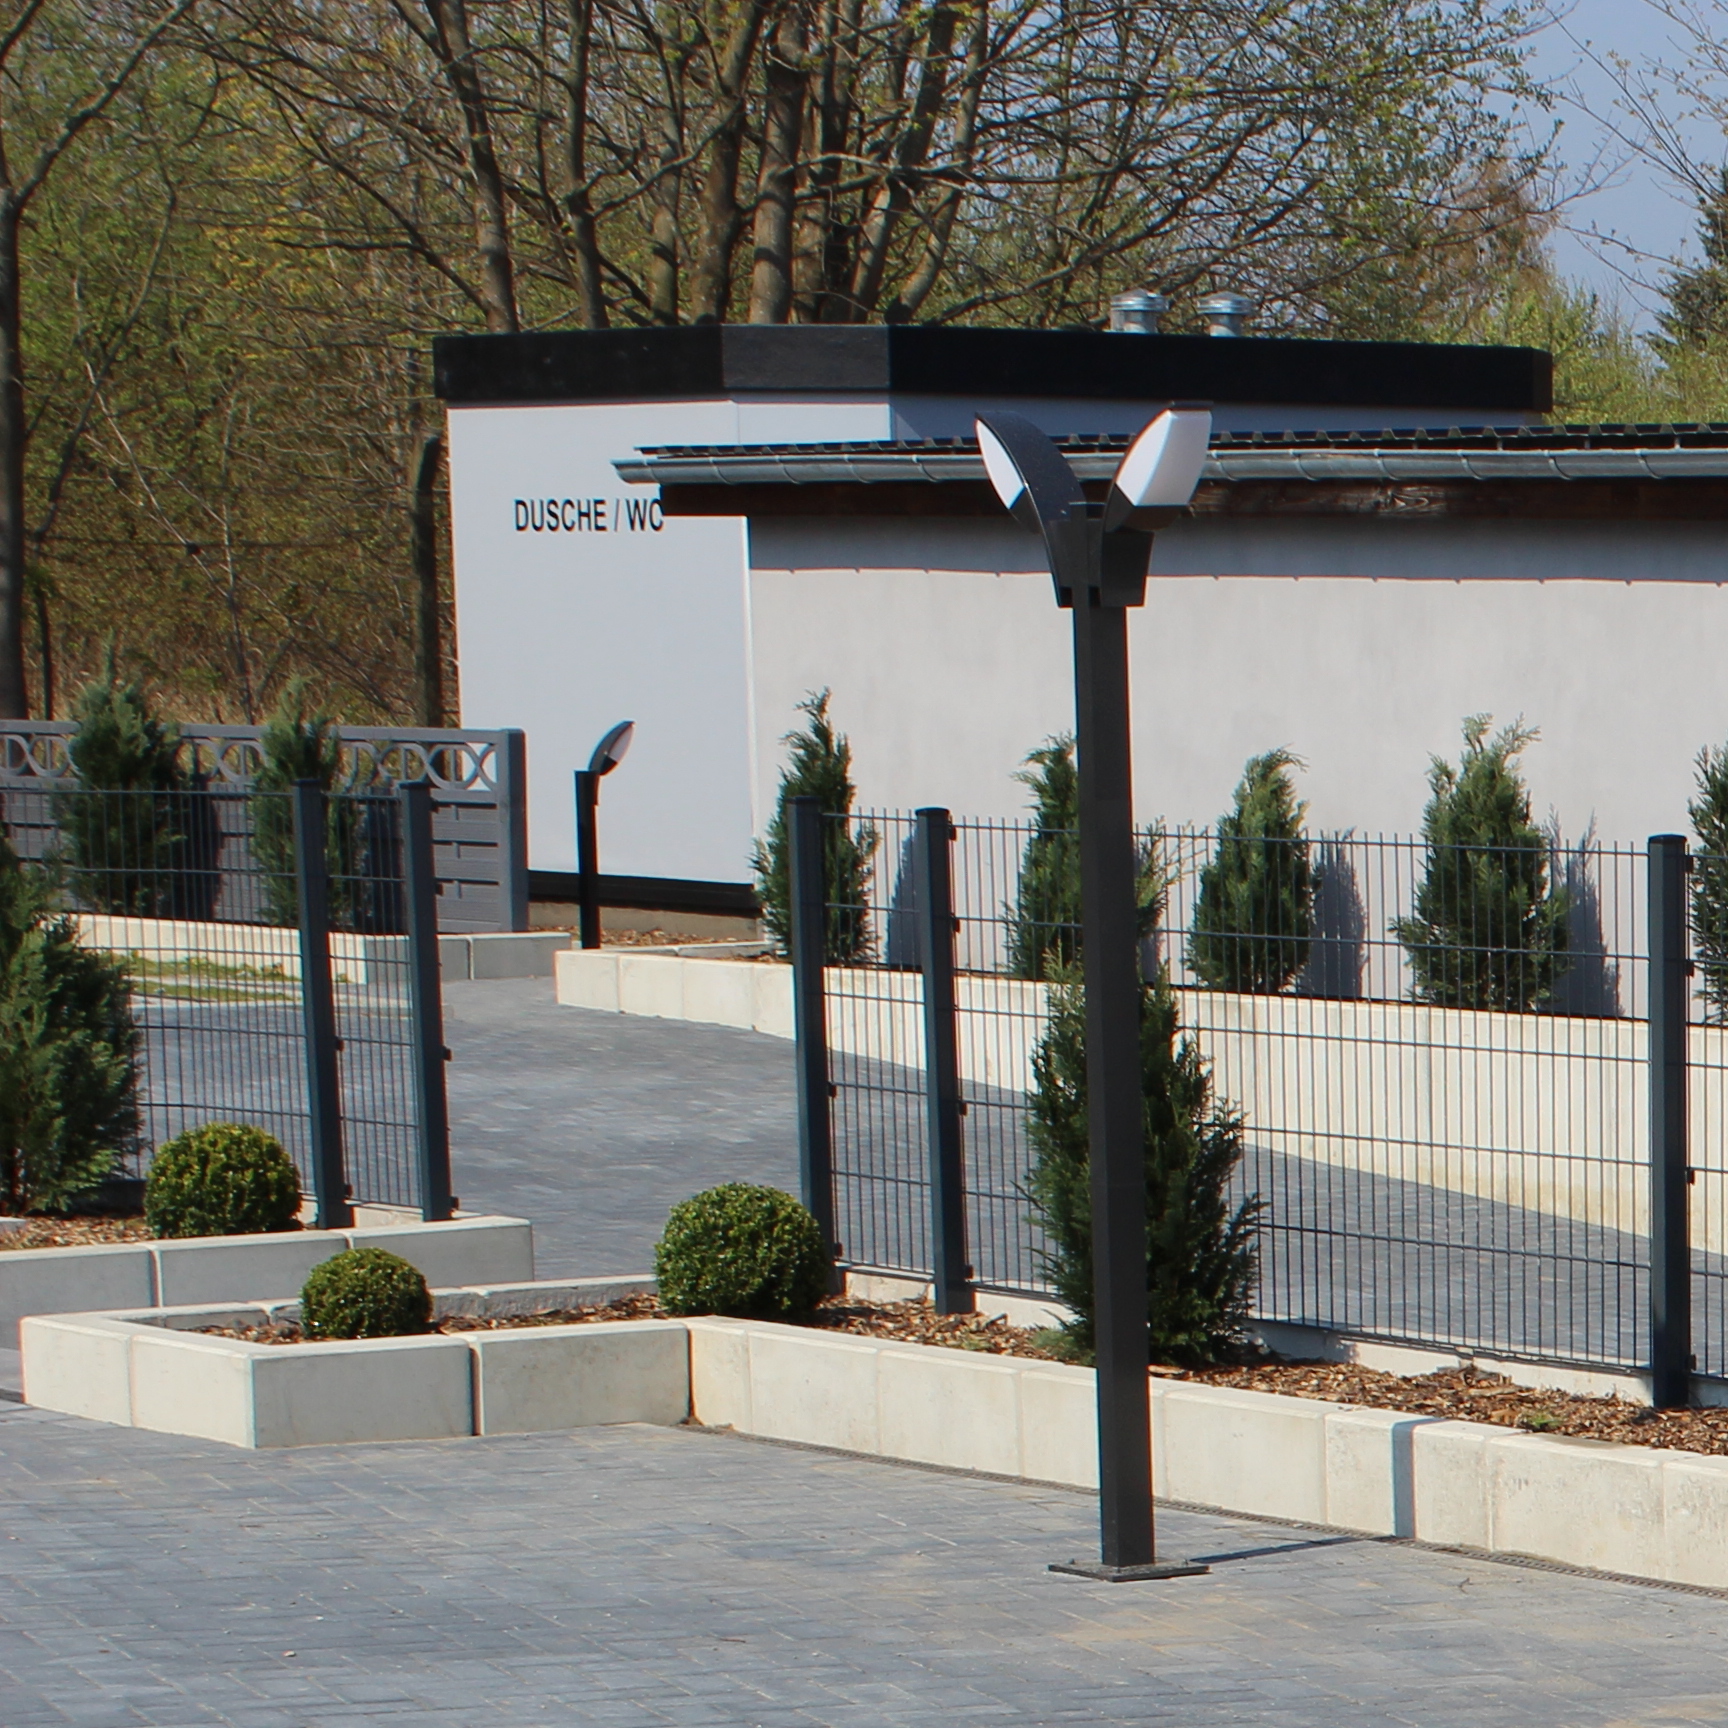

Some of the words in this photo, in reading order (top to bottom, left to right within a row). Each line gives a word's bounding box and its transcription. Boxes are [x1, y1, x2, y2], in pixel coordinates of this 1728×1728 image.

[515, 499, 607, 531] DUSCHE
[614, 499, 621, 532] /
[626, 499, 664, 531] WC
